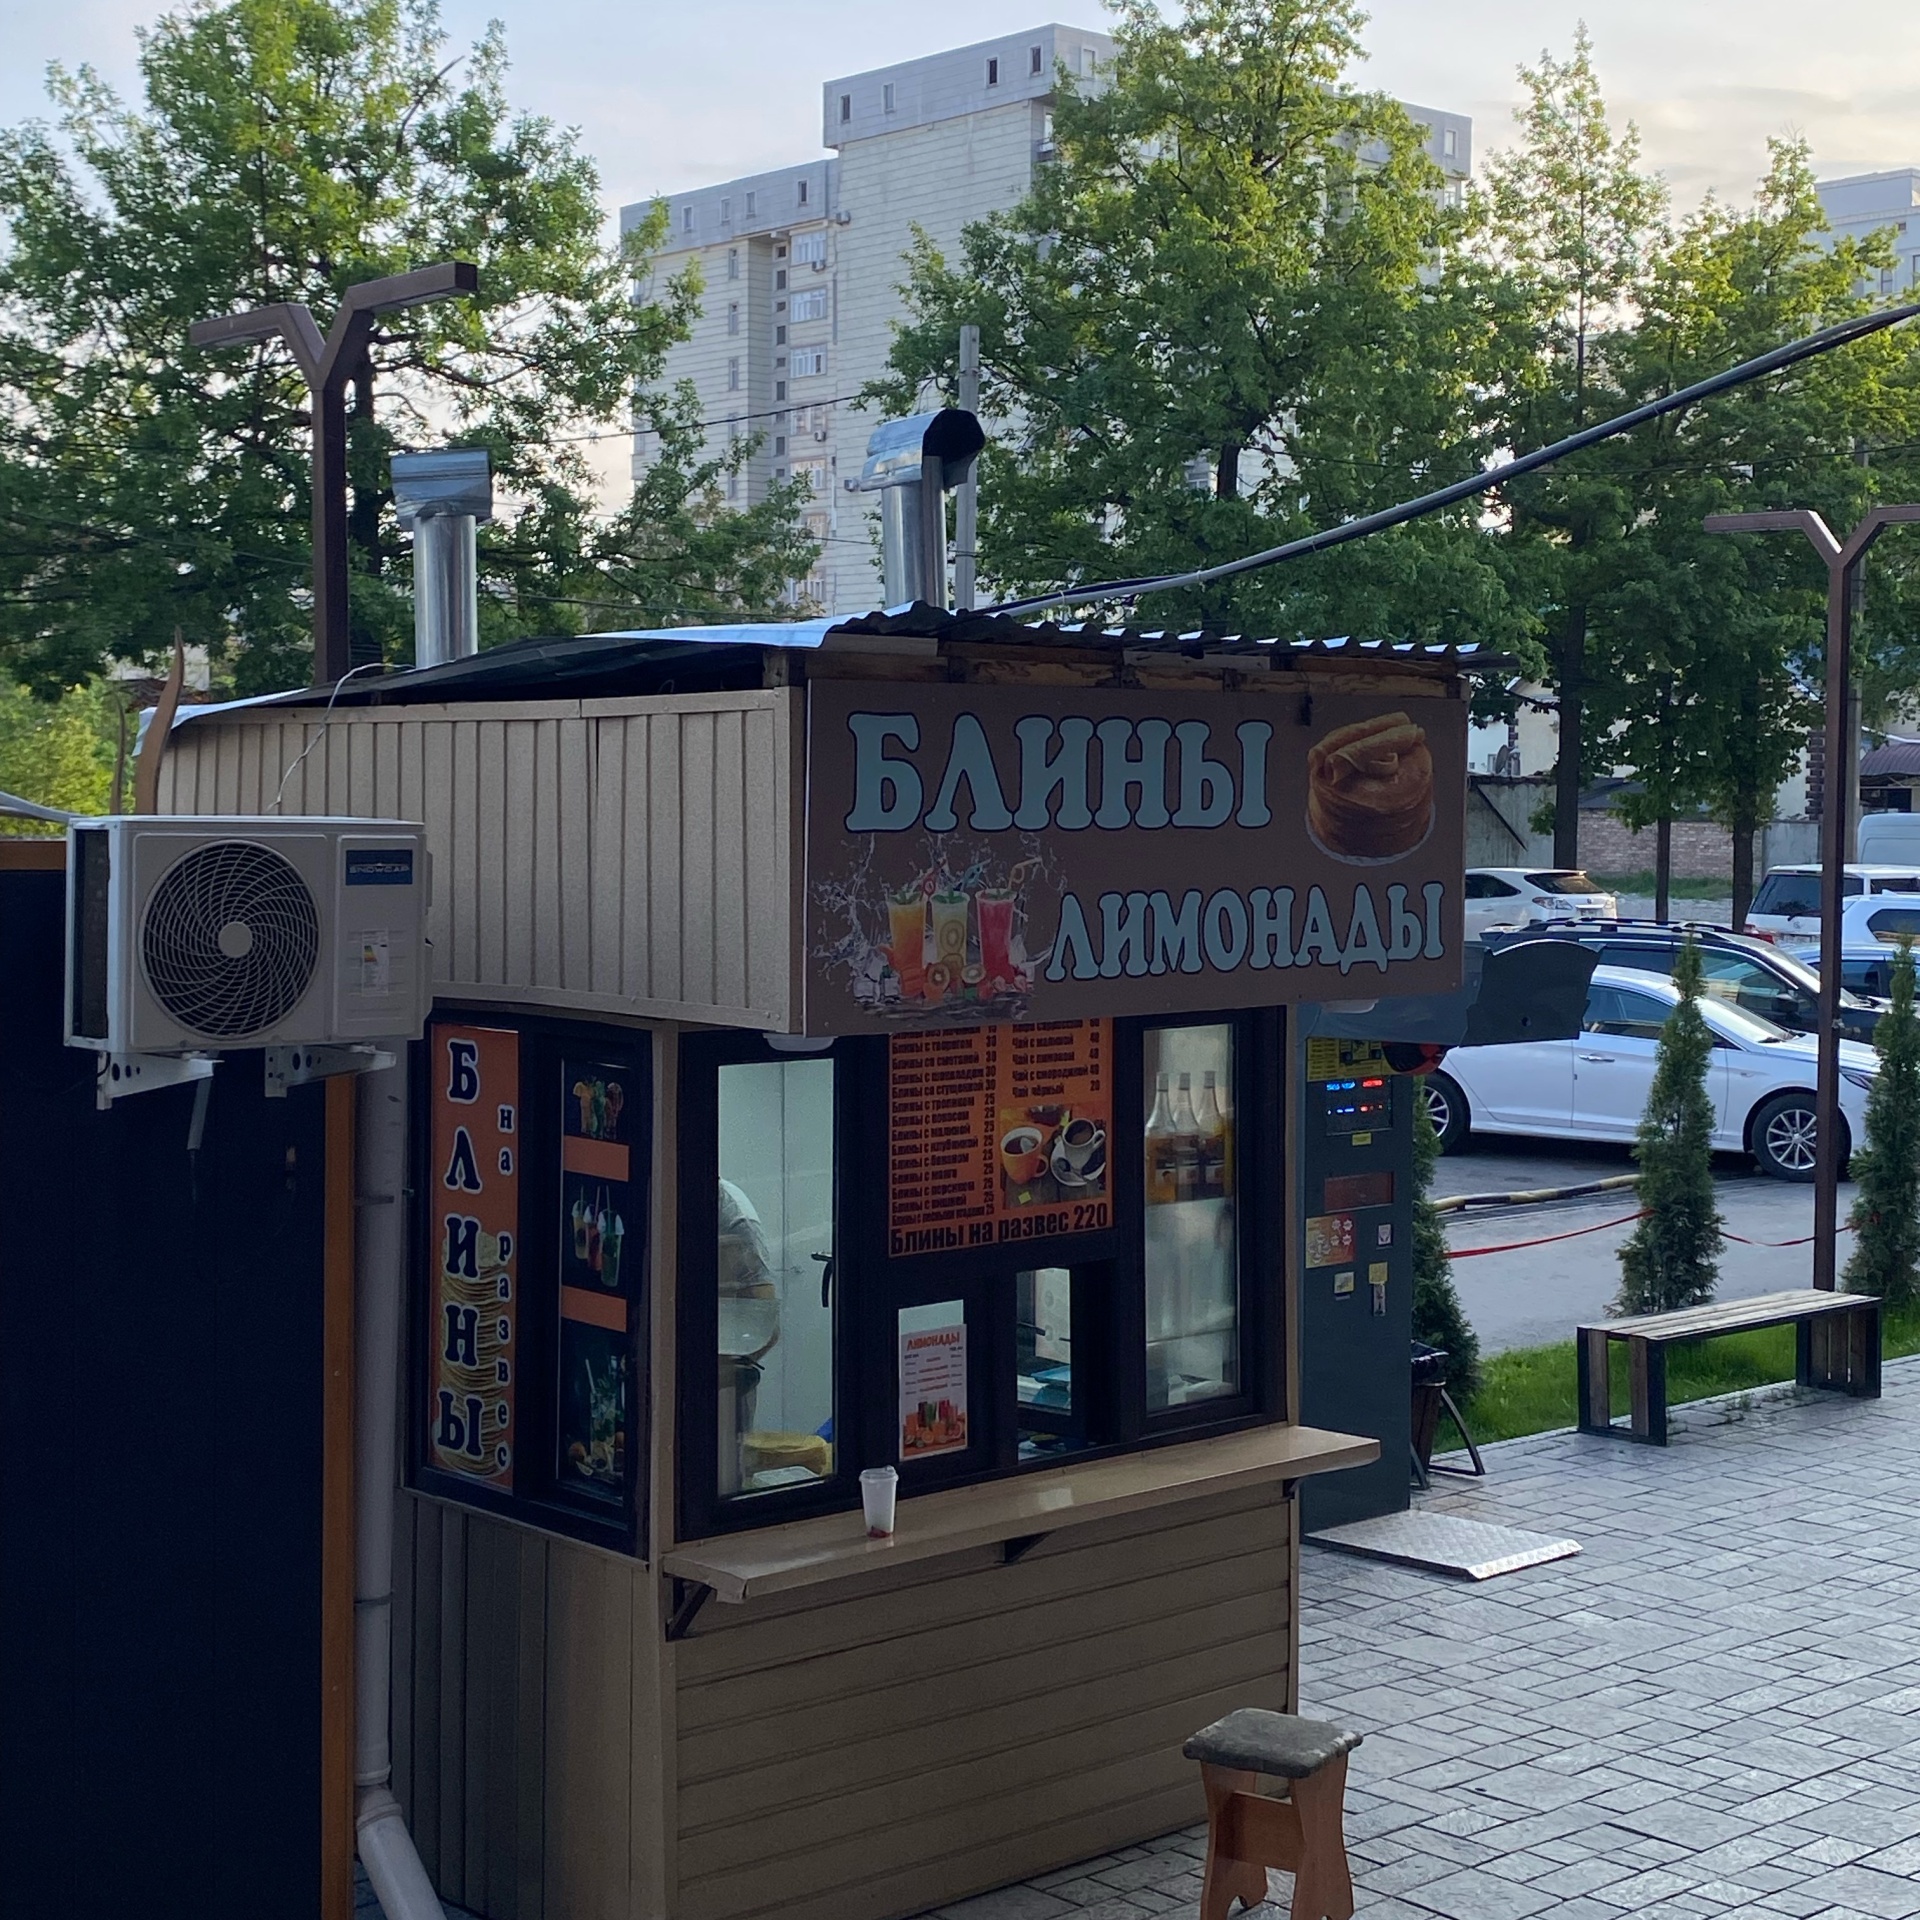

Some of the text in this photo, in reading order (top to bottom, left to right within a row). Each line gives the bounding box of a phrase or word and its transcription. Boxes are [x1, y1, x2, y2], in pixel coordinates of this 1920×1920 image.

[845, 712, 1273, 832] БЛИНЫ
[349, 865, 410, 873] SNOWCAP
[1045, 882, 1445, 982] ЛИМОНАДЫ
[892, 1043, 922, 1054] Блины
[925, 1042, 930, 1051] с
[987, 1036, 996, 1047] 30
[1013, 1036, 1028, 1048] Чай
[1030, 1039, 1034, 1047] с
[893, 1051, 996, 1069] Блины со сметаной 30
[1013, 1053, 1028, 1064] Чай
[1030, 1055, 1034, 1063] с
[893, 1074, 922, 1084] Блины
[925, 1073, 930, 1082] с
[986, 1066, 996, 1076] 30
[1013, 1070, 1028, 1081] Чай
[1030, 1071, 1034, 1080] с
[892, 1088, 922, 1098] Блины
[925, 1086, 934, 1095] со
[986, 1080, 995, 1090] 30
[1013, 1086, 1028, 1097] Чай
[893, 1102, 922, 1112] Блины
[925, 1101, 930, 1109] с
[985, 1094, 995, 1104] 25
[893, 1116, 922, 1127] Блины
[925, 1115, 930, 1124] с
[985, 1107, 994, 1118] 25
[892, 1130, 922, 1141] Блины
[925, 1129, 929, 1138] с
[985, 1121, 994, 1132] 25
[892, 1135, 993, 1155] Блины с клубникой 25
[892, 1159, 922, 1170] Блины
[925, 1158, 929, 1166] с
[983, 1149, 992, 1160] 25
[893, 1173, 922, 1184] Блины
[925, 1172, 929, 1181] с
[984, 1163, 993, 1174] 25
[893, 1187, 922, 1199] Блины
[925, 1187, 929, 1195] с
[983, 1178, 993, 1189] 25
[893, 1202, 922, 1213] Блины
[925, 1201, 929, 1209] с
[984, 1192, 994, 1203] 25
[891, 1203, 1107, 1254] Блины на развес 220
[893, 1215, 916, 1225] Блины
[435, 1041, 482, 1457] БЛИНЫ
[498, 1105, 513, 1468] на развес
[907, 1332, 960, 1351] ЛИМОНАДЫ
